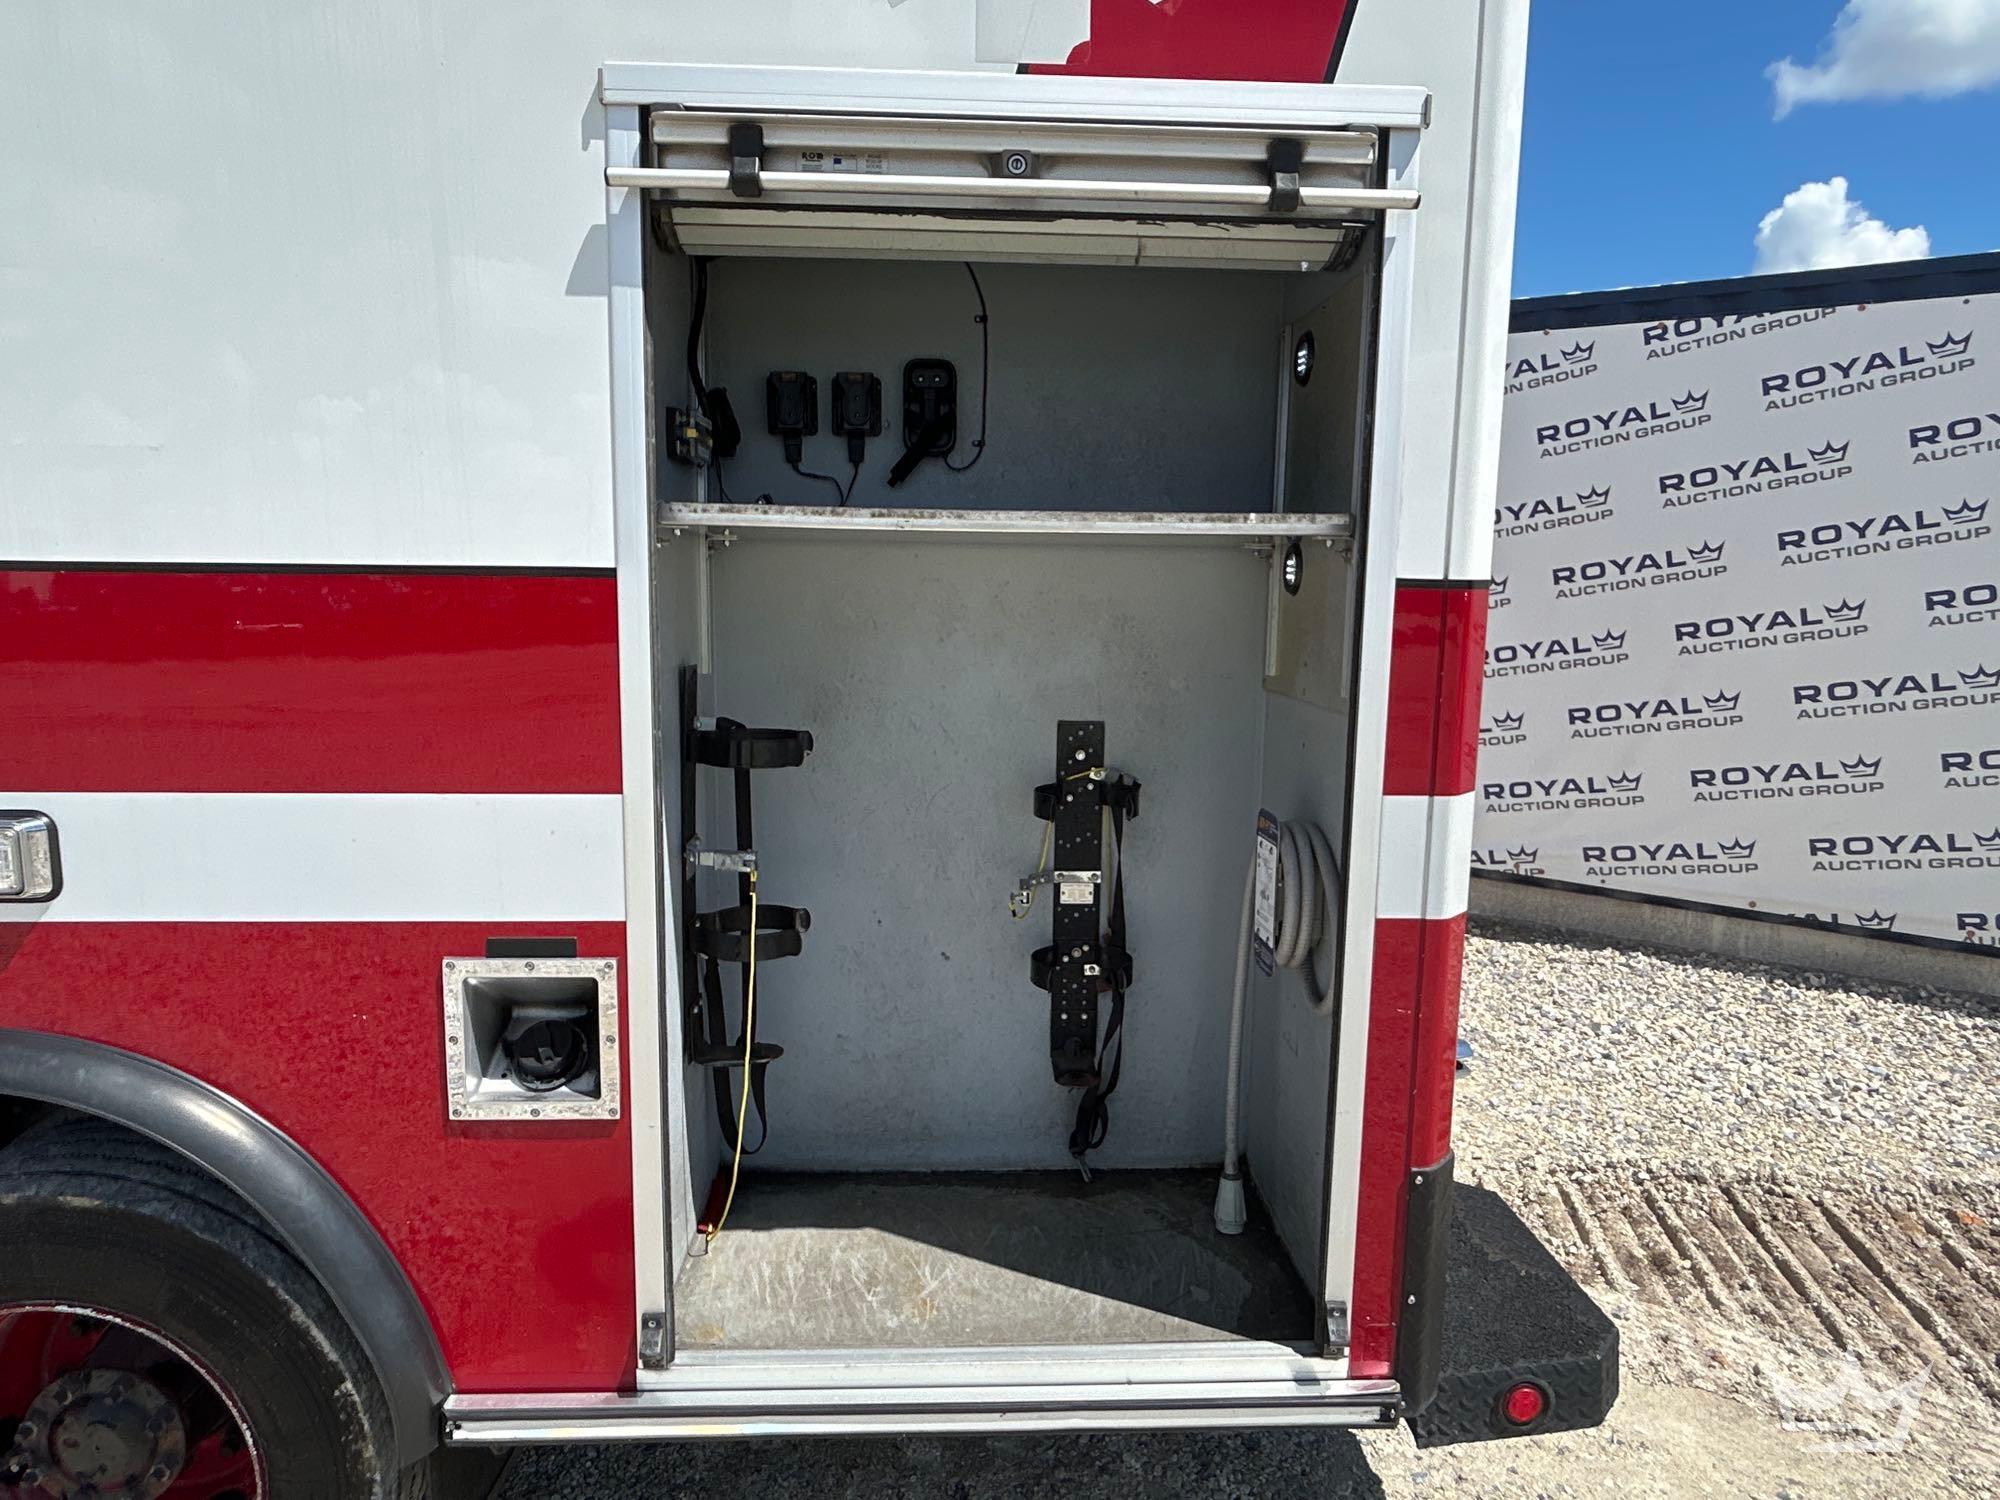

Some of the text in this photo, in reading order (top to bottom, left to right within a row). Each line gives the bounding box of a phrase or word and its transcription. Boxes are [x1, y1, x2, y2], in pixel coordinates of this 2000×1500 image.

[1646, 307, 1837, 361] AUCTION GROUP
[1528, 364, 1598, 389] GROUP
[1761, 346, 1925, 397] ROYAL
[1764, 358, 1976, 412] AUCTION GROUP
[1536, 402, 1671, 446] ROYAL
[1540, 414, 1712, 459] AUCTION GROUP
[1659, 452, 1808, 494] ROYAL
[1662, 466, 1853, 509] AUCTION GROUP
[1543, 509, 1614, 530] GROUP
[1777, 510, 1942, 551] ROYAL
[1780, 525, 1992, 567] AUCTION GROUP
[1552, 550, 1687, 586] ROYAL
[1555, 565, 1728, 600] AUCTION GROUP
[1924, 584, 1999, 611] RO
[1674, 607, 1824, 642] ROYAL
[1678, 624, 1869, 657] AUCTION GROUP
[1558, 653, 1630, 671] GROUP
[1793, 673, 1957, 705] ROYAL
[1568, 697, 1703, 726] ROYAL
[1796, 700, 1907, 720] AUCTION
[1571, 715, 1744, 739] AUCTION GROUP
[1483, 776, 1607, 800] ROYAL
[1690, 762, 1839, 788] ROYAL
[1485, 795, 1645, 814] AUCTION GROUP
[1693, 781, 1884, 803] AUCTION GROUP
[1582, 842, 1718, 863] ROYAL
[1809, 833, 1973, 857] ROYAL
[1586, 862, 1759, 877] AUCTION GROUP
[1812, 858, 1922, 872] AUCTION
